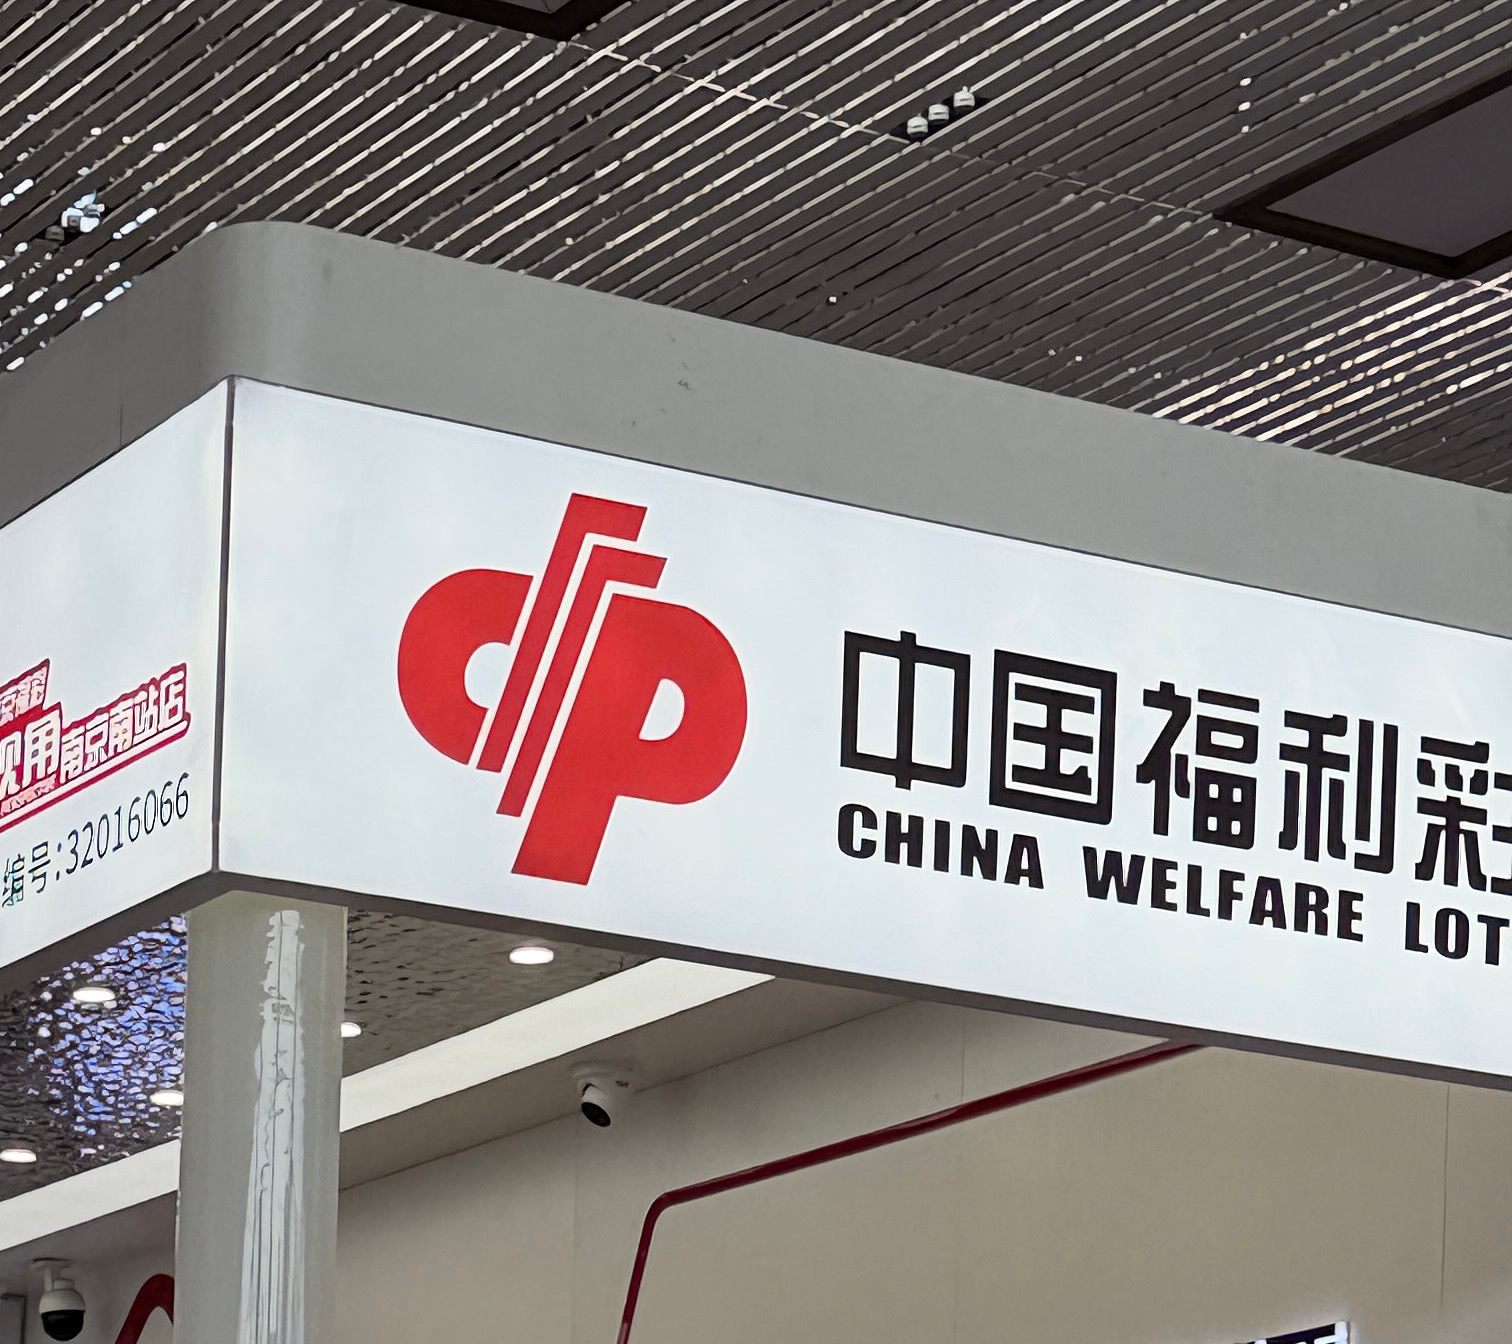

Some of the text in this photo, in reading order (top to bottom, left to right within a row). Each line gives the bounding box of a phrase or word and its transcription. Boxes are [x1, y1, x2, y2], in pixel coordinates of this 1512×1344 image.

[837, 802, 1512, 966] CHINA WELFARE LOT
